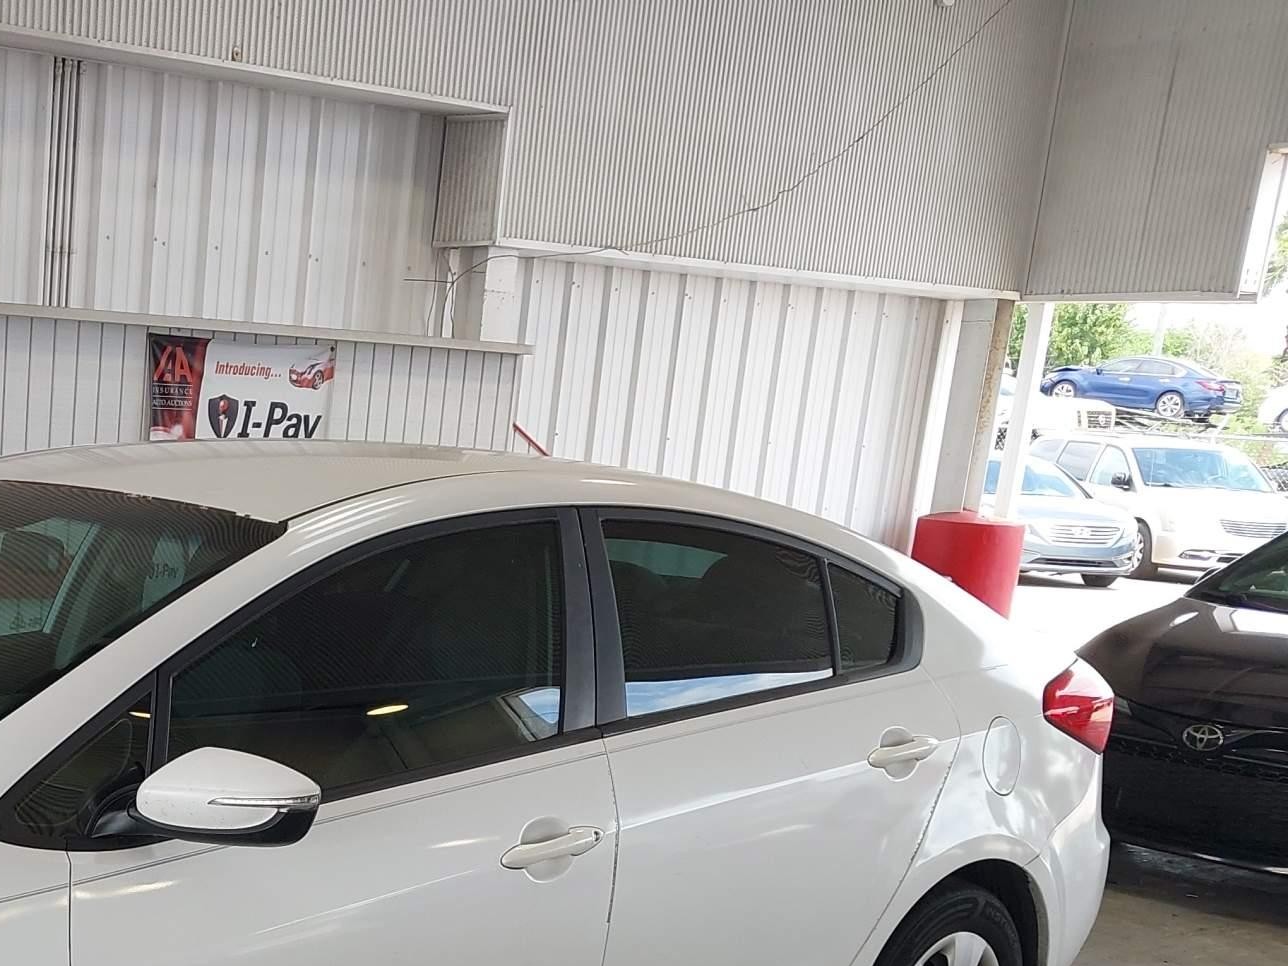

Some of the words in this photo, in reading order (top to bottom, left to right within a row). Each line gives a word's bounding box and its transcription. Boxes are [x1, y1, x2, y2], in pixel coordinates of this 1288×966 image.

[215, 360, 281, 380] Introducing...
[152, 386, 193, 395] INSURANCE
[166, 399, 193, 408] AUCTIONS
